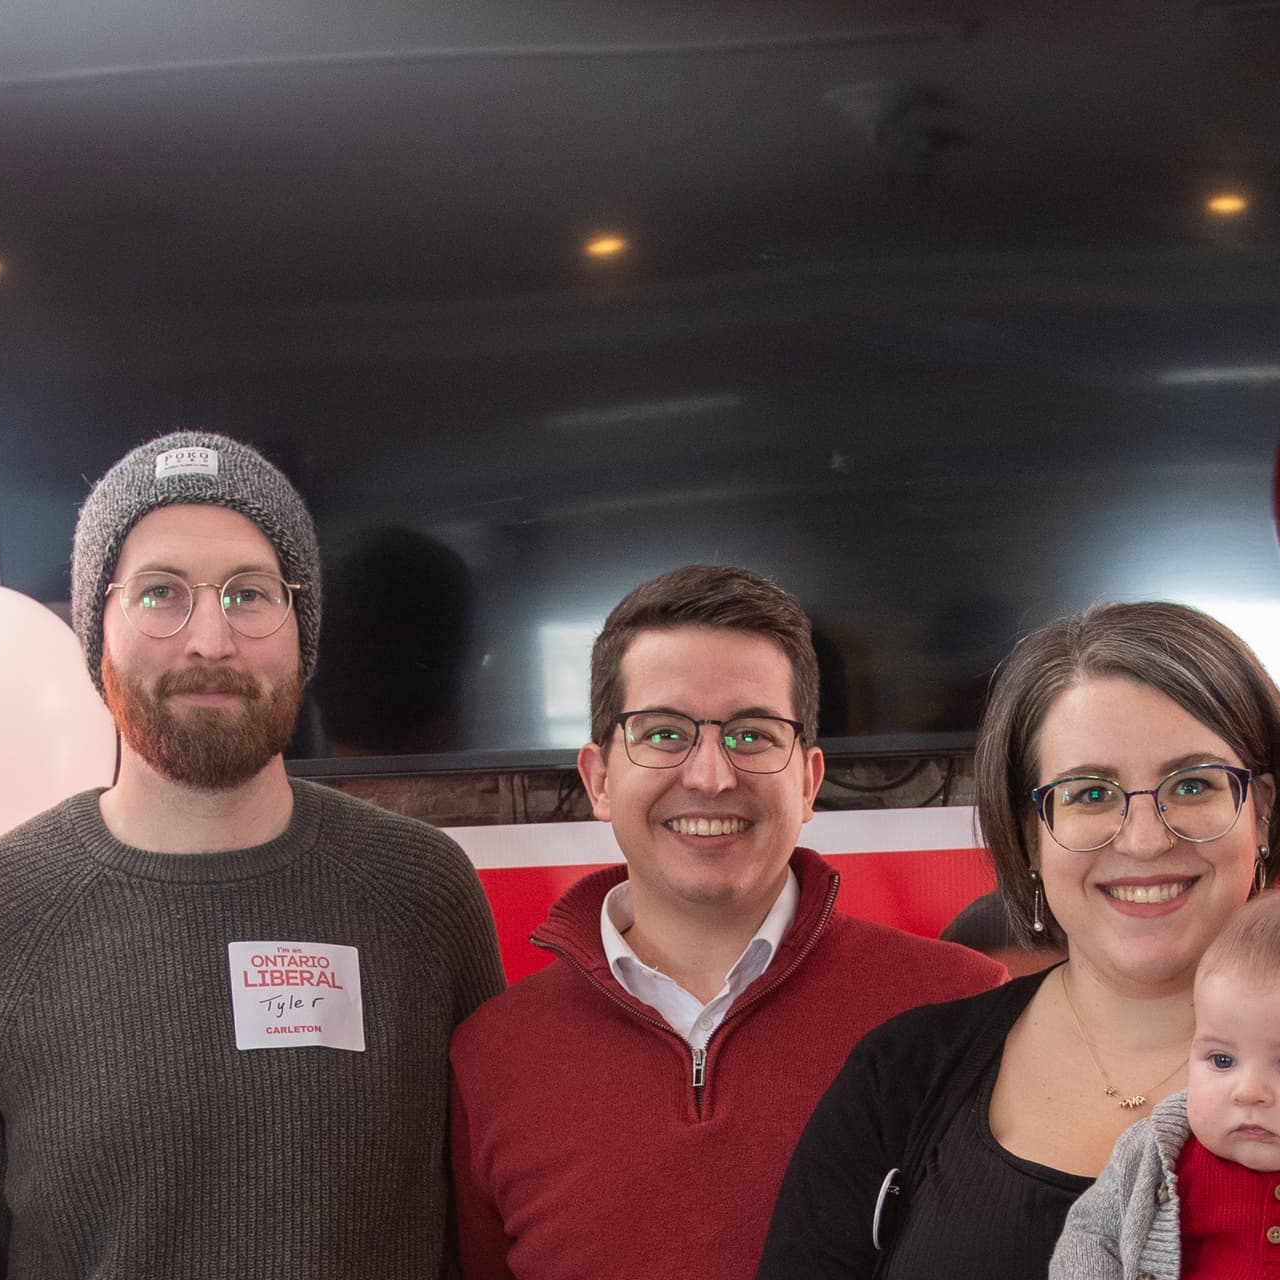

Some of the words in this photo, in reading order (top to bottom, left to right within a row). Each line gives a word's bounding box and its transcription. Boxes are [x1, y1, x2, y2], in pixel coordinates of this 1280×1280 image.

[251, 955, 330, 968] ONTARIO
[243, 970, 344, 990] LIBERAL
[259, 994, 325, 1017] Tyler
[266, 1025, 322, 1034] CARLETON
